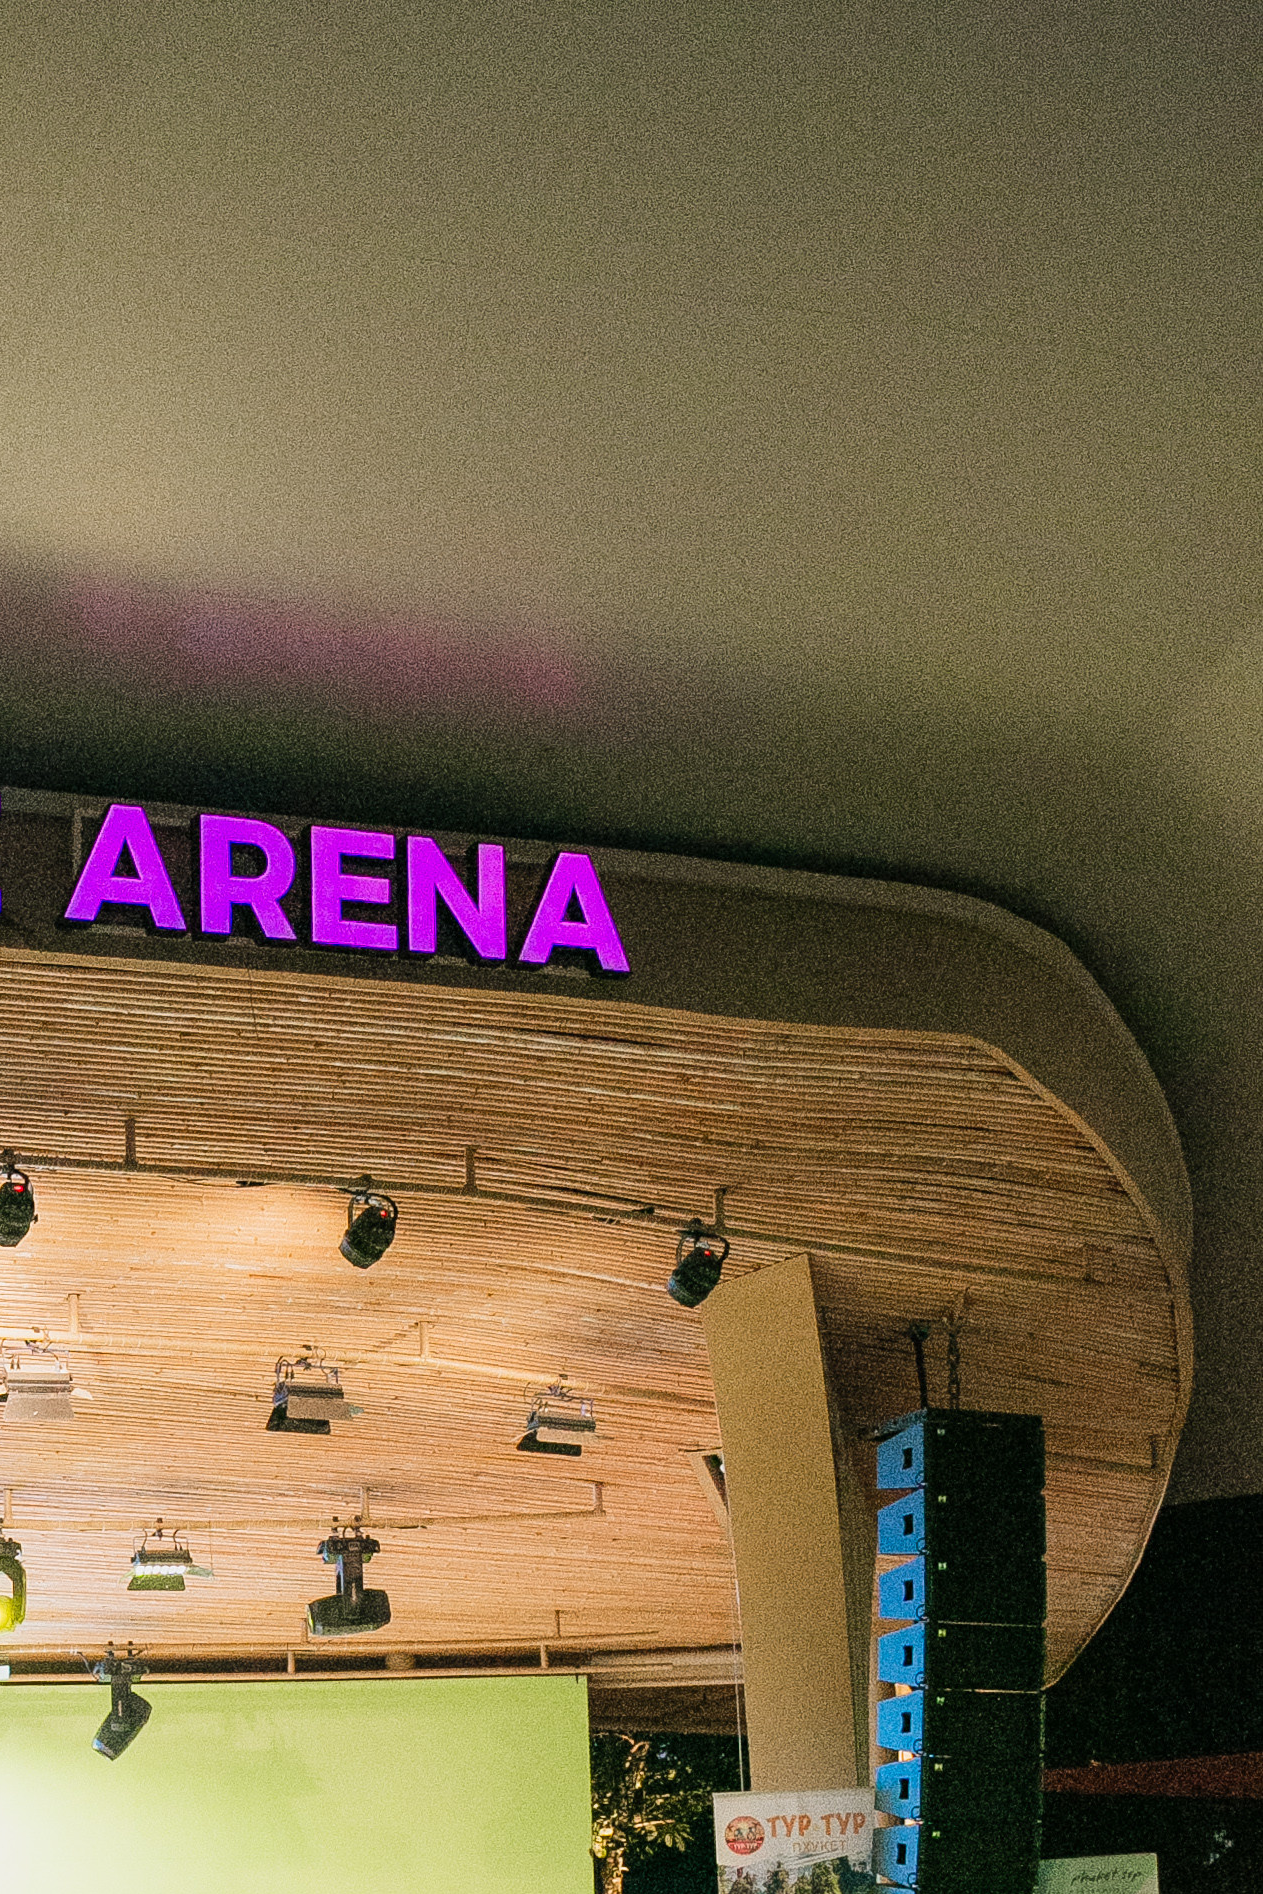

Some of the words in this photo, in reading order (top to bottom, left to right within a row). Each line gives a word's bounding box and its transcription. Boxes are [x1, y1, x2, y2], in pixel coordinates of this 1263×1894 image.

[69, 803, 630, 972] ARENA
[766, 1814, 812, 1838] ТУР
[820, 1812, 867, 1837] ТУР
[792, 1839, 848, 1854] ПХУКЕТ
